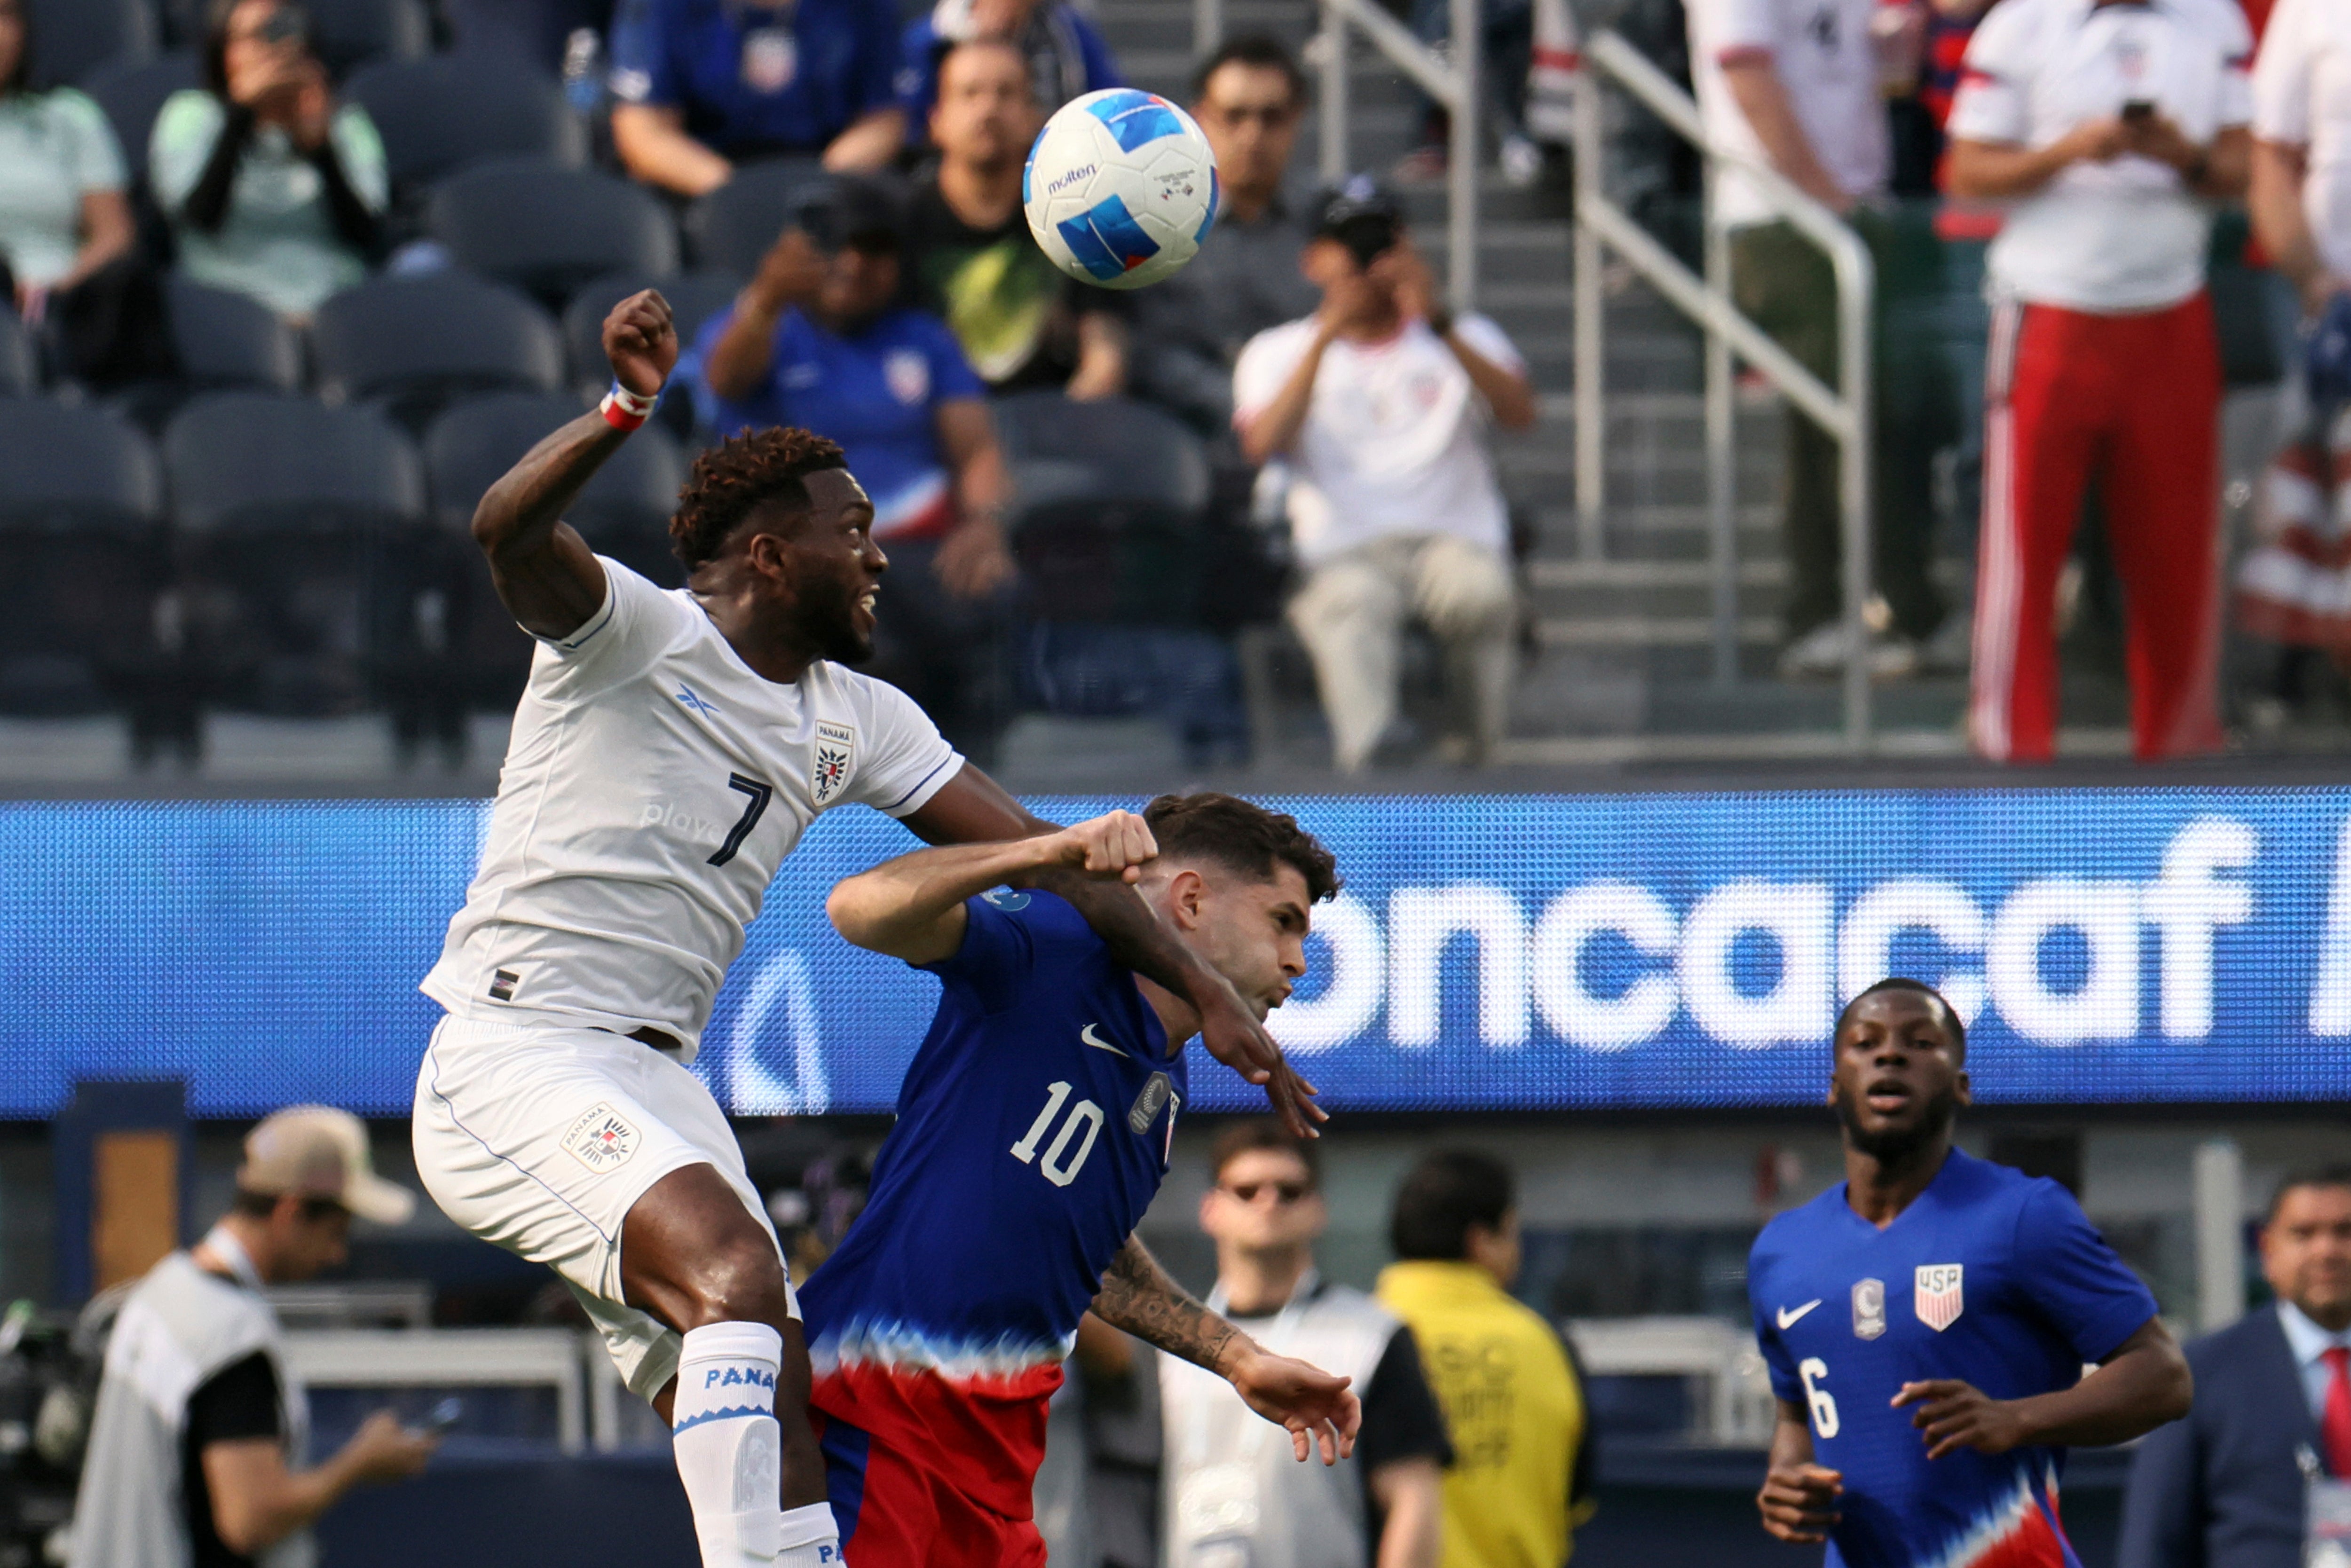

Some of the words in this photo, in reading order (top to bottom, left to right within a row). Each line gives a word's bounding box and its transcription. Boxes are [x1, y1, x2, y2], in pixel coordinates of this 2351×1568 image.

[1048, 164, 1097, 194] molten
[706, 772, 773, 867] 7
[1262, 813, 2258, 1056] oncacaf
[566, 1107, 606, 1145] PANAMA
[1010, 1080, 1104, 1187] 10
[1799, 1357, 1840, 1439] 6
